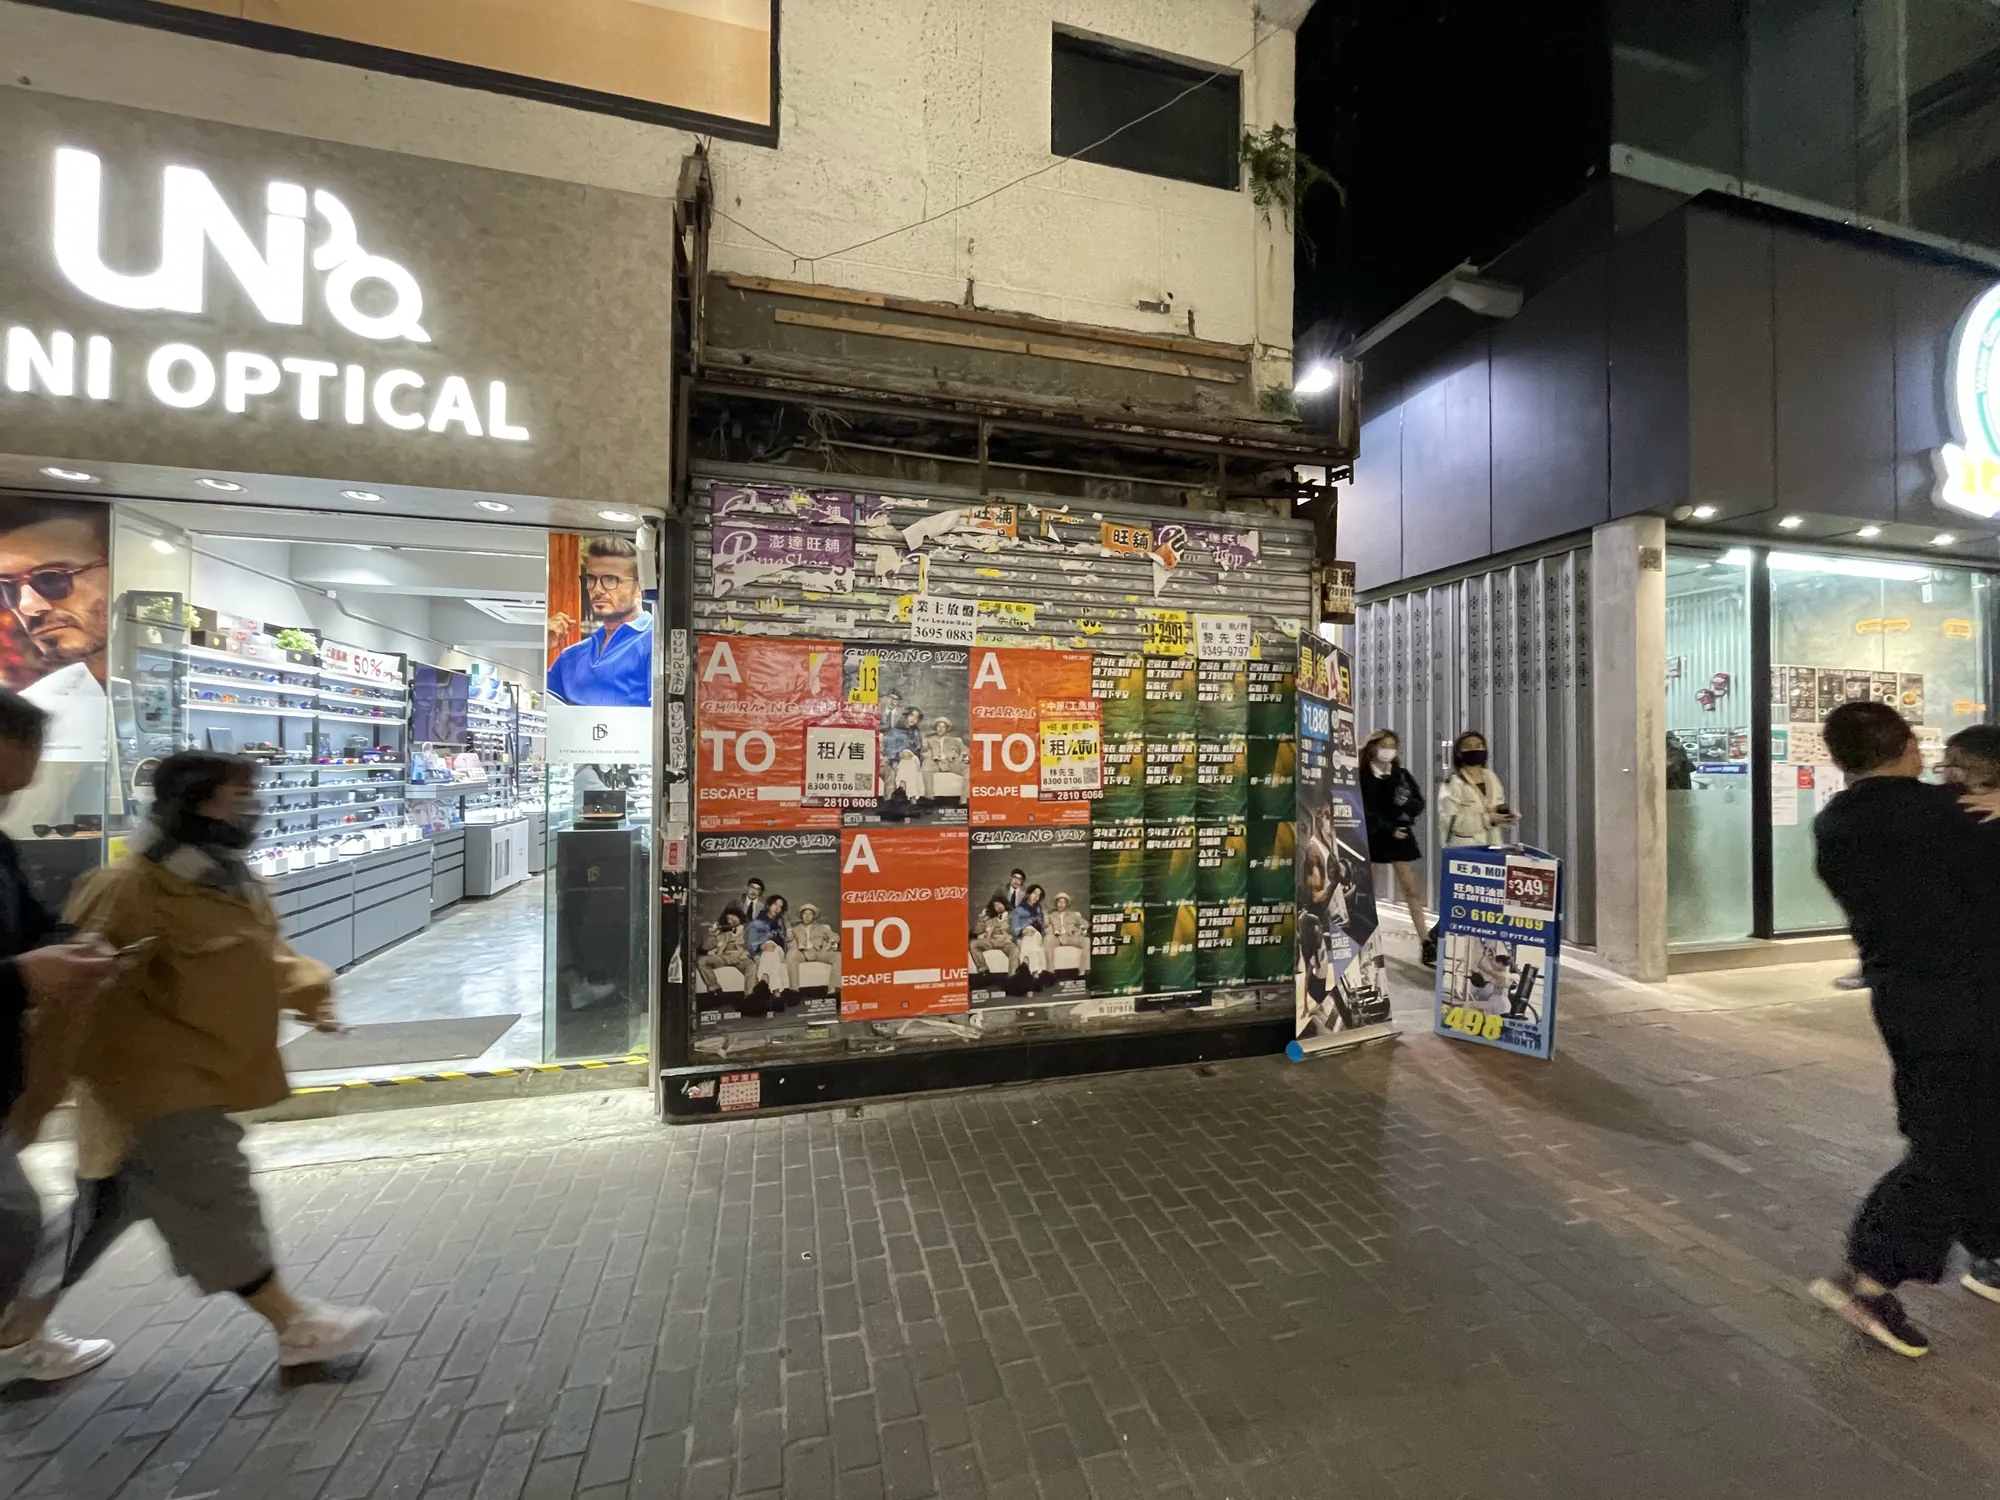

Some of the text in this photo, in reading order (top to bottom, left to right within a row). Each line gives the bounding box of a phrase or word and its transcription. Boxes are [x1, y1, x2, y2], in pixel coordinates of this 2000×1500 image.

[147, 342, 530, 441] OPTICAL
[914, 626, 974, 642] 3695 0883
[935, 650, 969, 664] WAY
[1202, 645, 1249, 657] 9349-9797
[703, 641, 741, 683] A
[973, 652, 1007, 690] A
[700, 730, 776, 773] TO
[817, 741, 866, 761] 租/售
[972, 732, 1036, 773] TO
[808, 782, 854, 791] 8300 0106
[1063, 777, 1082, 785] 0106
[700, 788, 755, 800] ESCAPE
[972, 786, 1018, 797] ESCAPE
[1057, 789, 1104, 801] 2810 6066
[823, 798, 878, 808] 2810 6066
[701, 833, 836, 850] CHARMING WAY
[971, 829, 1086, 843] CHARMING WAY
[843, 833, 880, 874] A
[1457, 863, 1481, 876] 旺角
[843, 887, 968, 903] CHARMING WAY
[1508, 879, 1543, 896] $349
[1470, 908, 1504, 925] 6162
[842, 916, 911, 959] TO
[841, 967, 968, 986] ESCAPE LIVE
